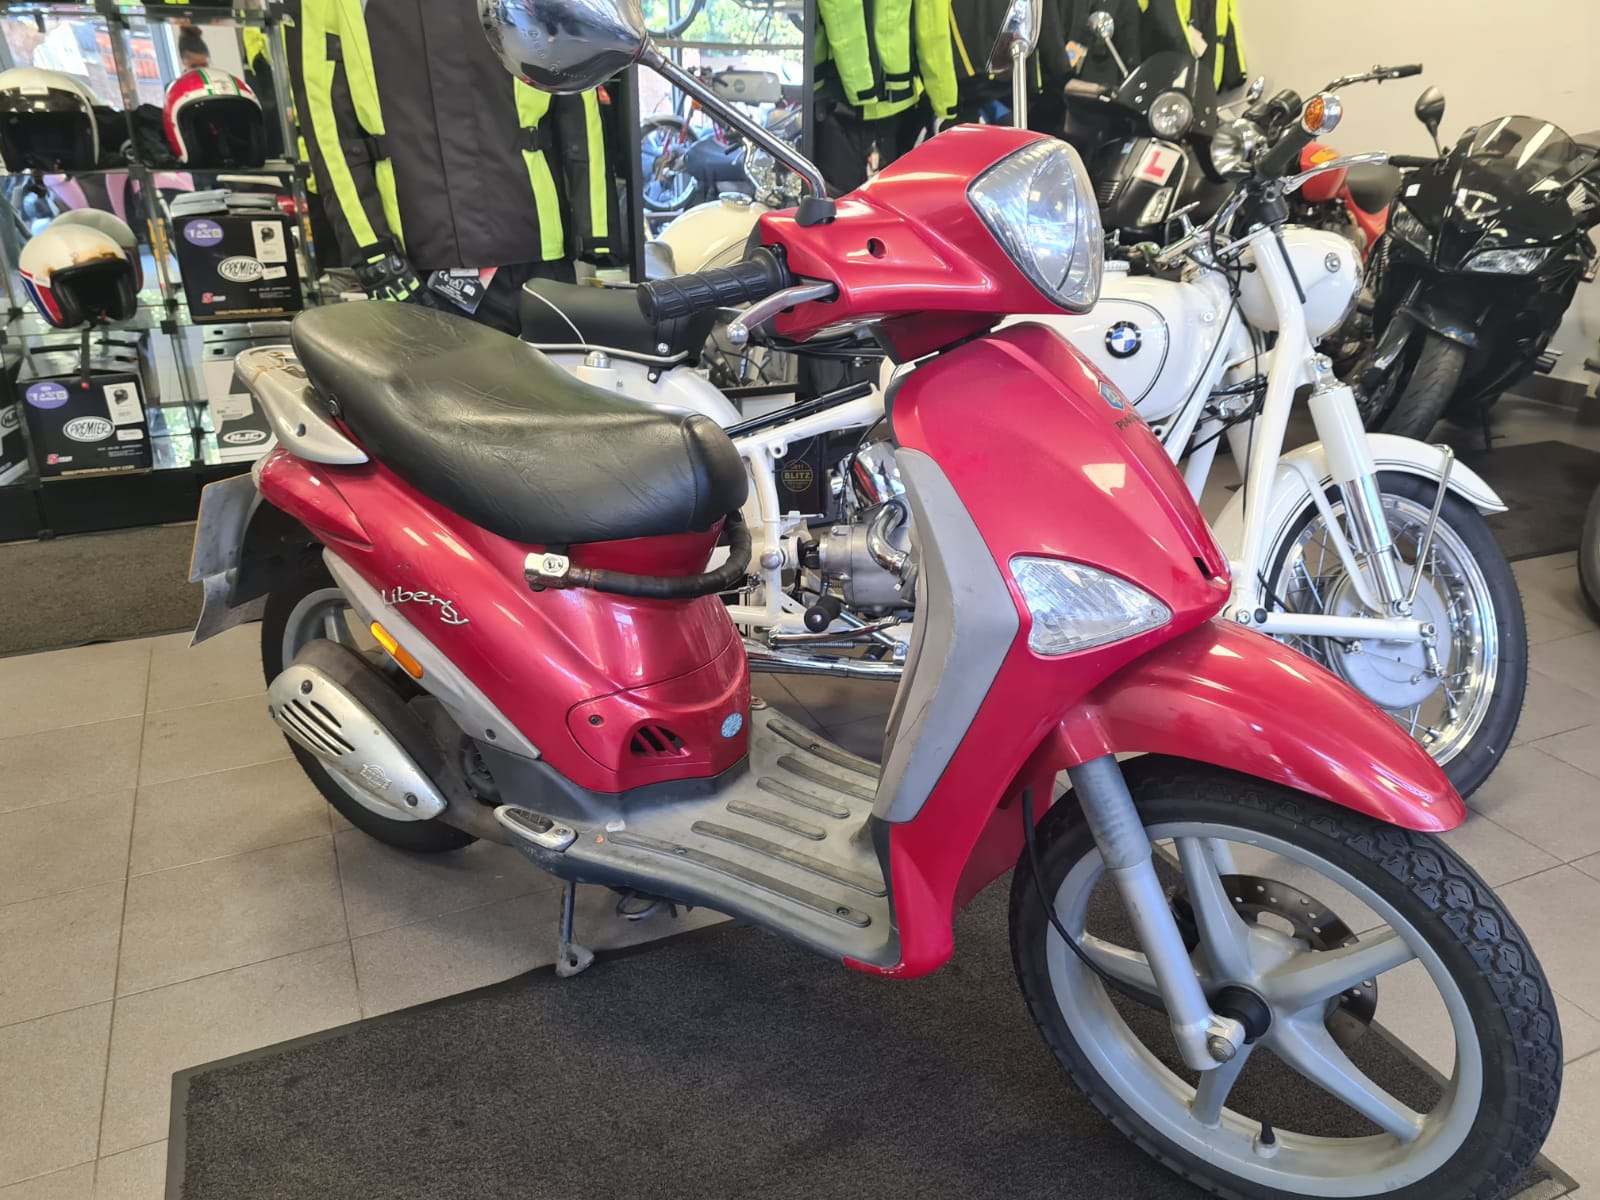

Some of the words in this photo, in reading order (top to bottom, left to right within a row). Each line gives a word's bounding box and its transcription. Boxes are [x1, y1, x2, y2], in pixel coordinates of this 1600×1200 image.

[1143, 150, 1165, 177] L
[224, 261, 262, 277] PREMIER
[70, 421, 109, 437] PREMIER
[784, 471, 811, 479] BLITZ
[381, 586, 469, 624] Liberty
